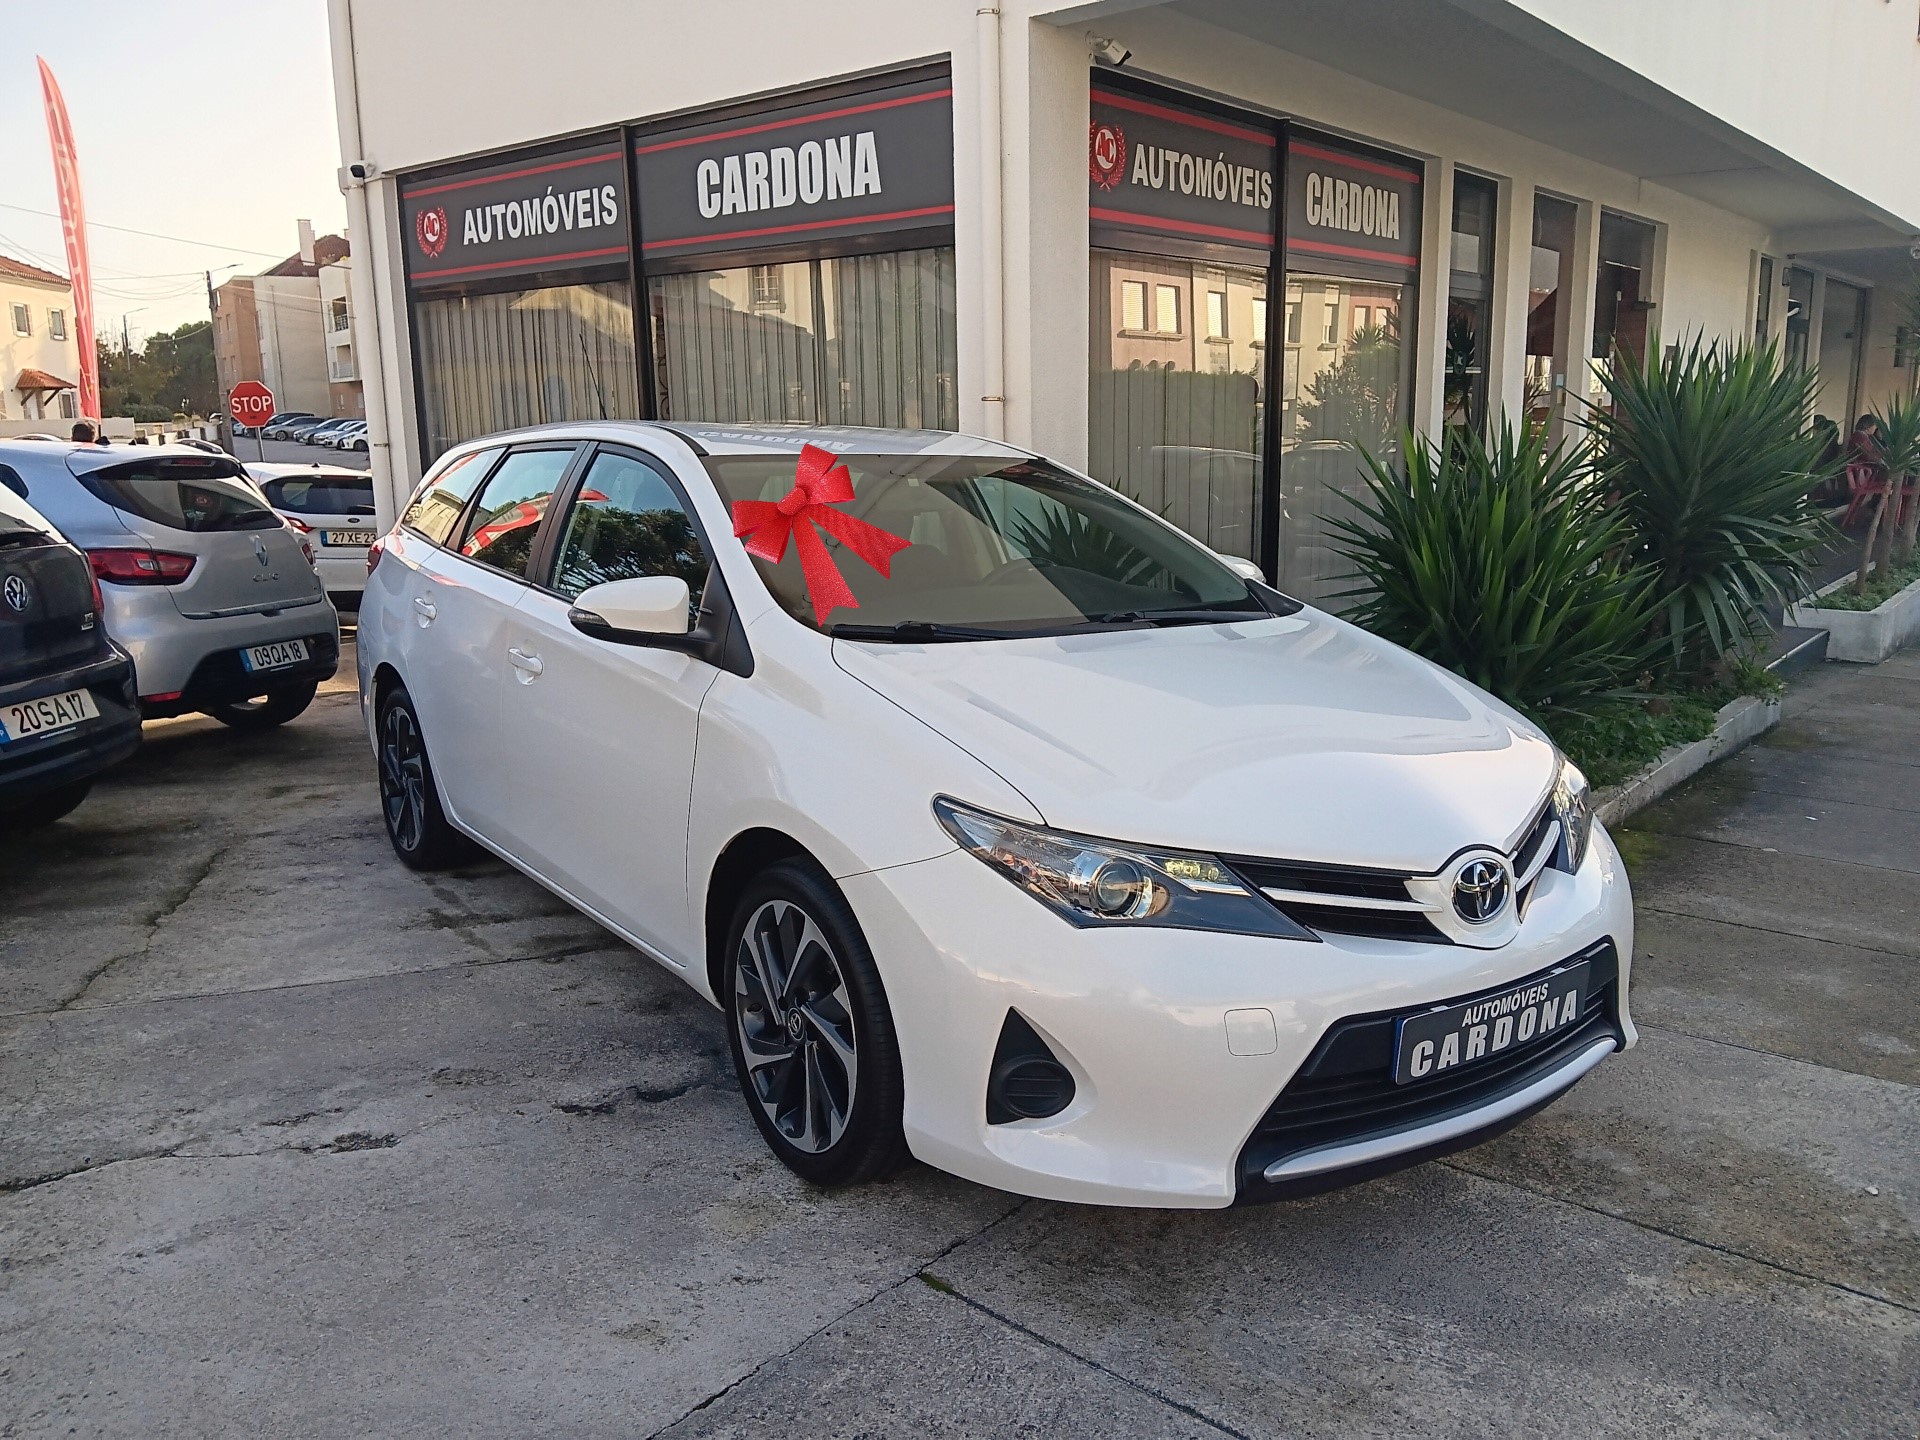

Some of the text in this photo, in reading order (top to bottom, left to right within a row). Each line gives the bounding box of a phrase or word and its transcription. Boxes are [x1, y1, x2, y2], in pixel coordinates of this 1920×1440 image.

[697, 131, 881, 219] CARDONA
[1131, 143, 1272, 209] AUTOMÓVEIS
[1305, 172, 1399, 240] CARDONA
[463, 185, 618, 245] AUTOMÓVEIS
[231, 395, 271, 413] STOP
[1410, 990, 1577, 1077] CARDONA
[1462, 983, 1549, 1028] AUTOMÓVEIS
